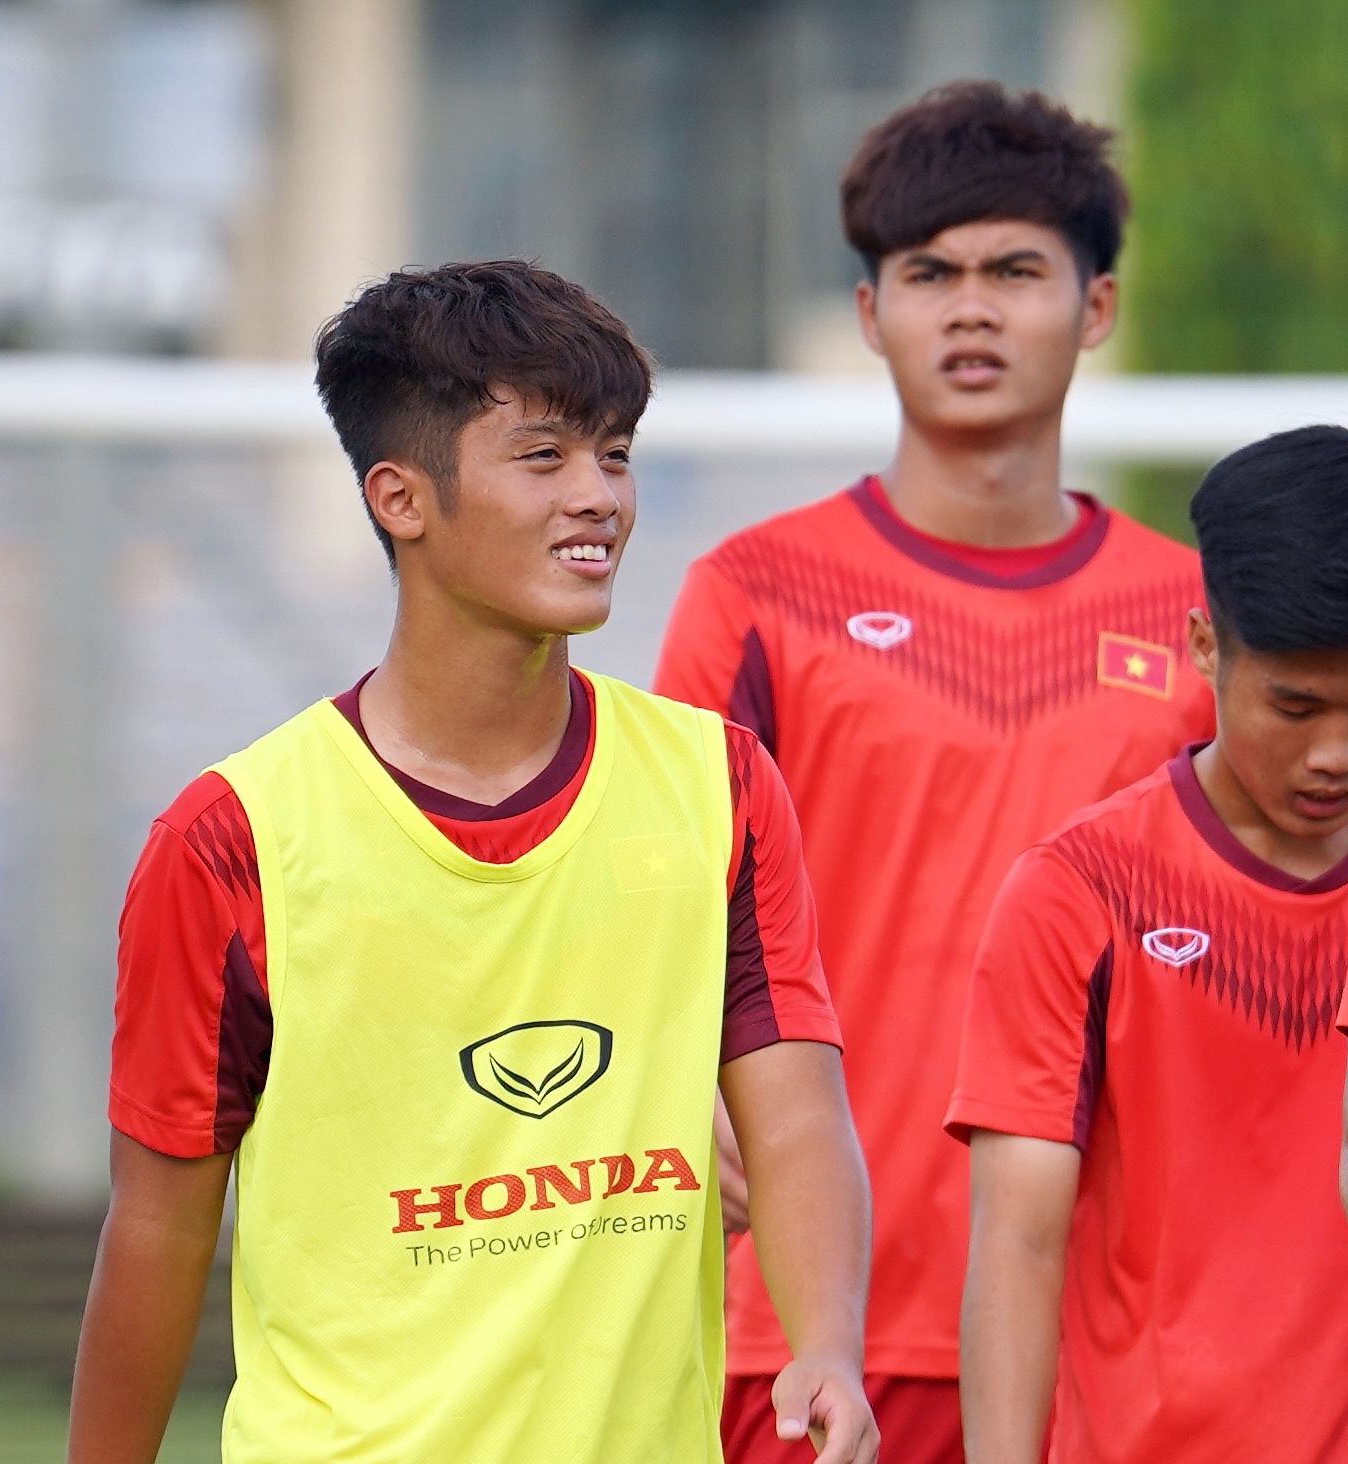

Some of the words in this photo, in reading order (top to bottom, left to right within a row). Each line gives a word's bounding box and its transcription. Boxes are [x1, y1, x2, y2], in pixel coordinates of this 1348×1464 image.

[389, 1147, 701, 1235] HONDA
[405, 1244, 462, 1268] The
[469, 1229, 564, 1259] Power
[570, 1218, 597, 1240] of
